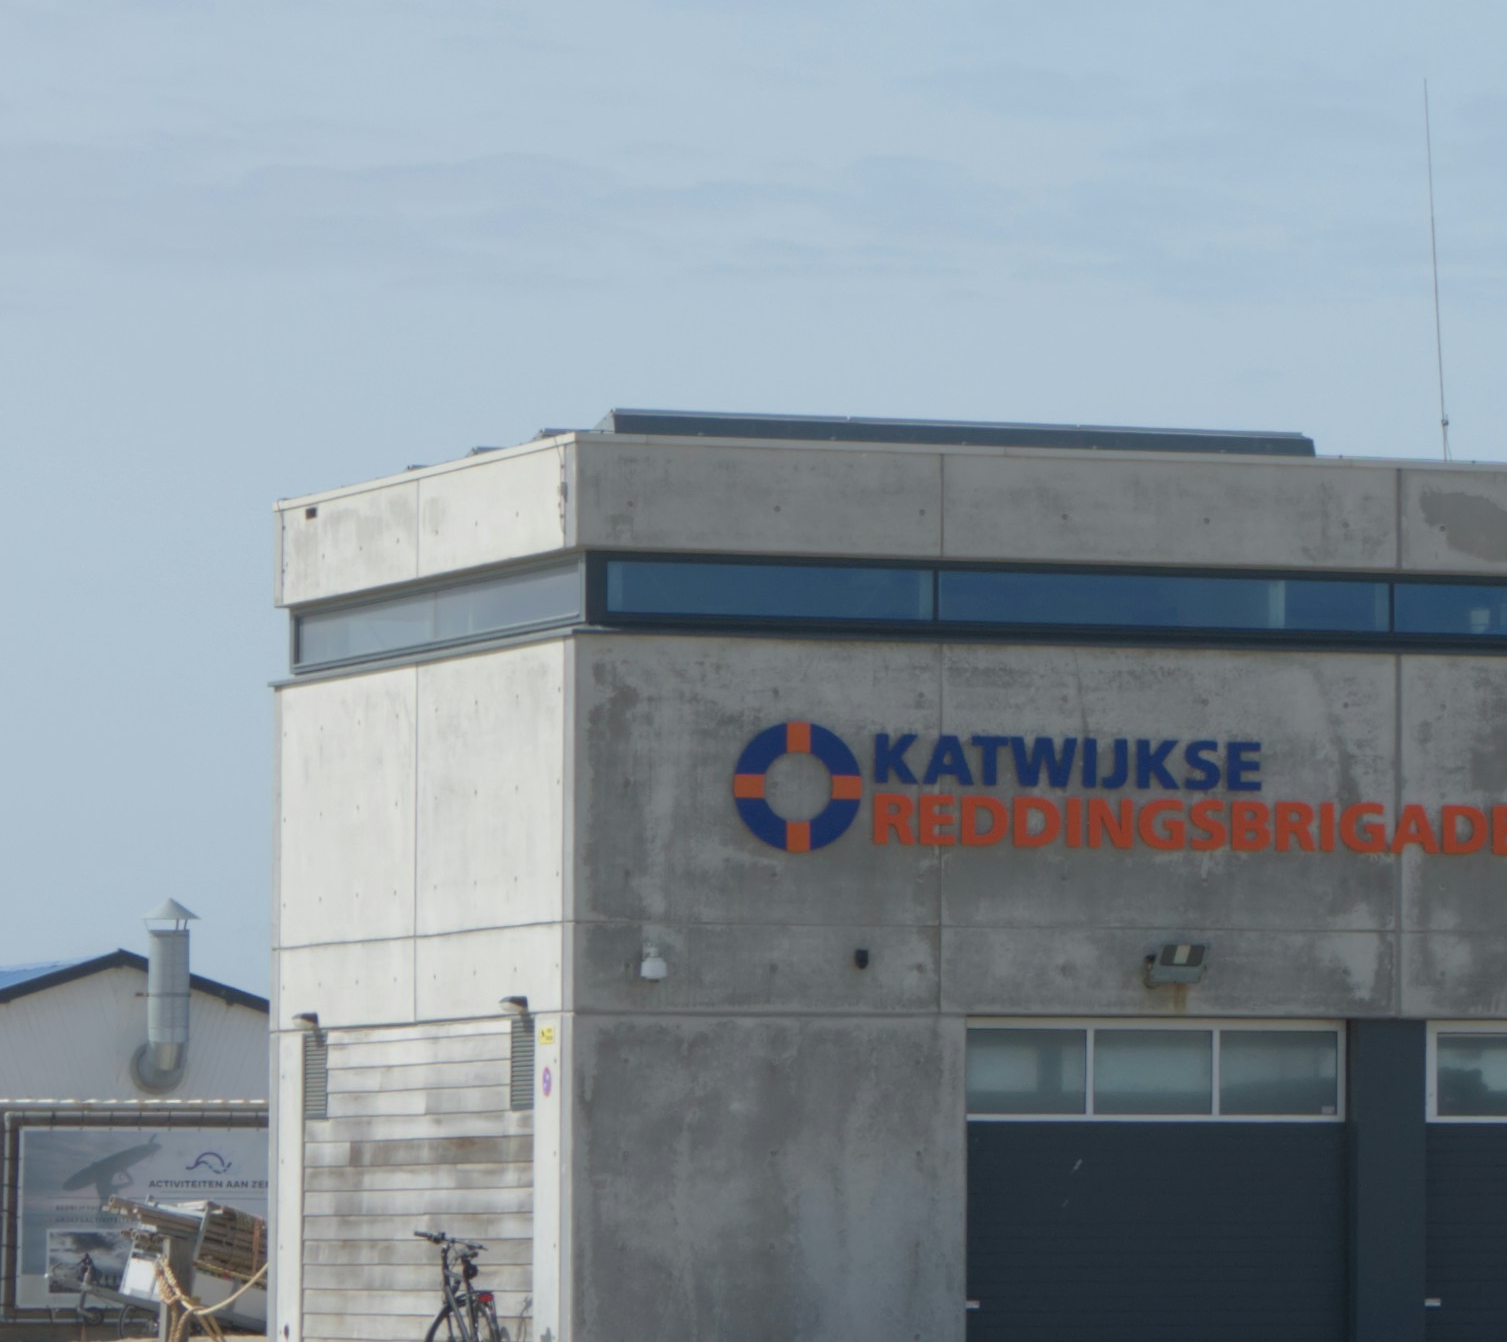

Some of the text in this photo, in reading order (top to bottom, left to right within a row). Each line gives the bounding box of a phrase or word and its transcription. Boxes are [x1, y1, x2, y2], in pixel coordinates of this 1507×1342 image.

[873, 732, 1263, 791] KATWIJKSE
[148, 1180, 223, 1189] ACTIVITEITEN
[225, 1180, 249, 1189] AAN
